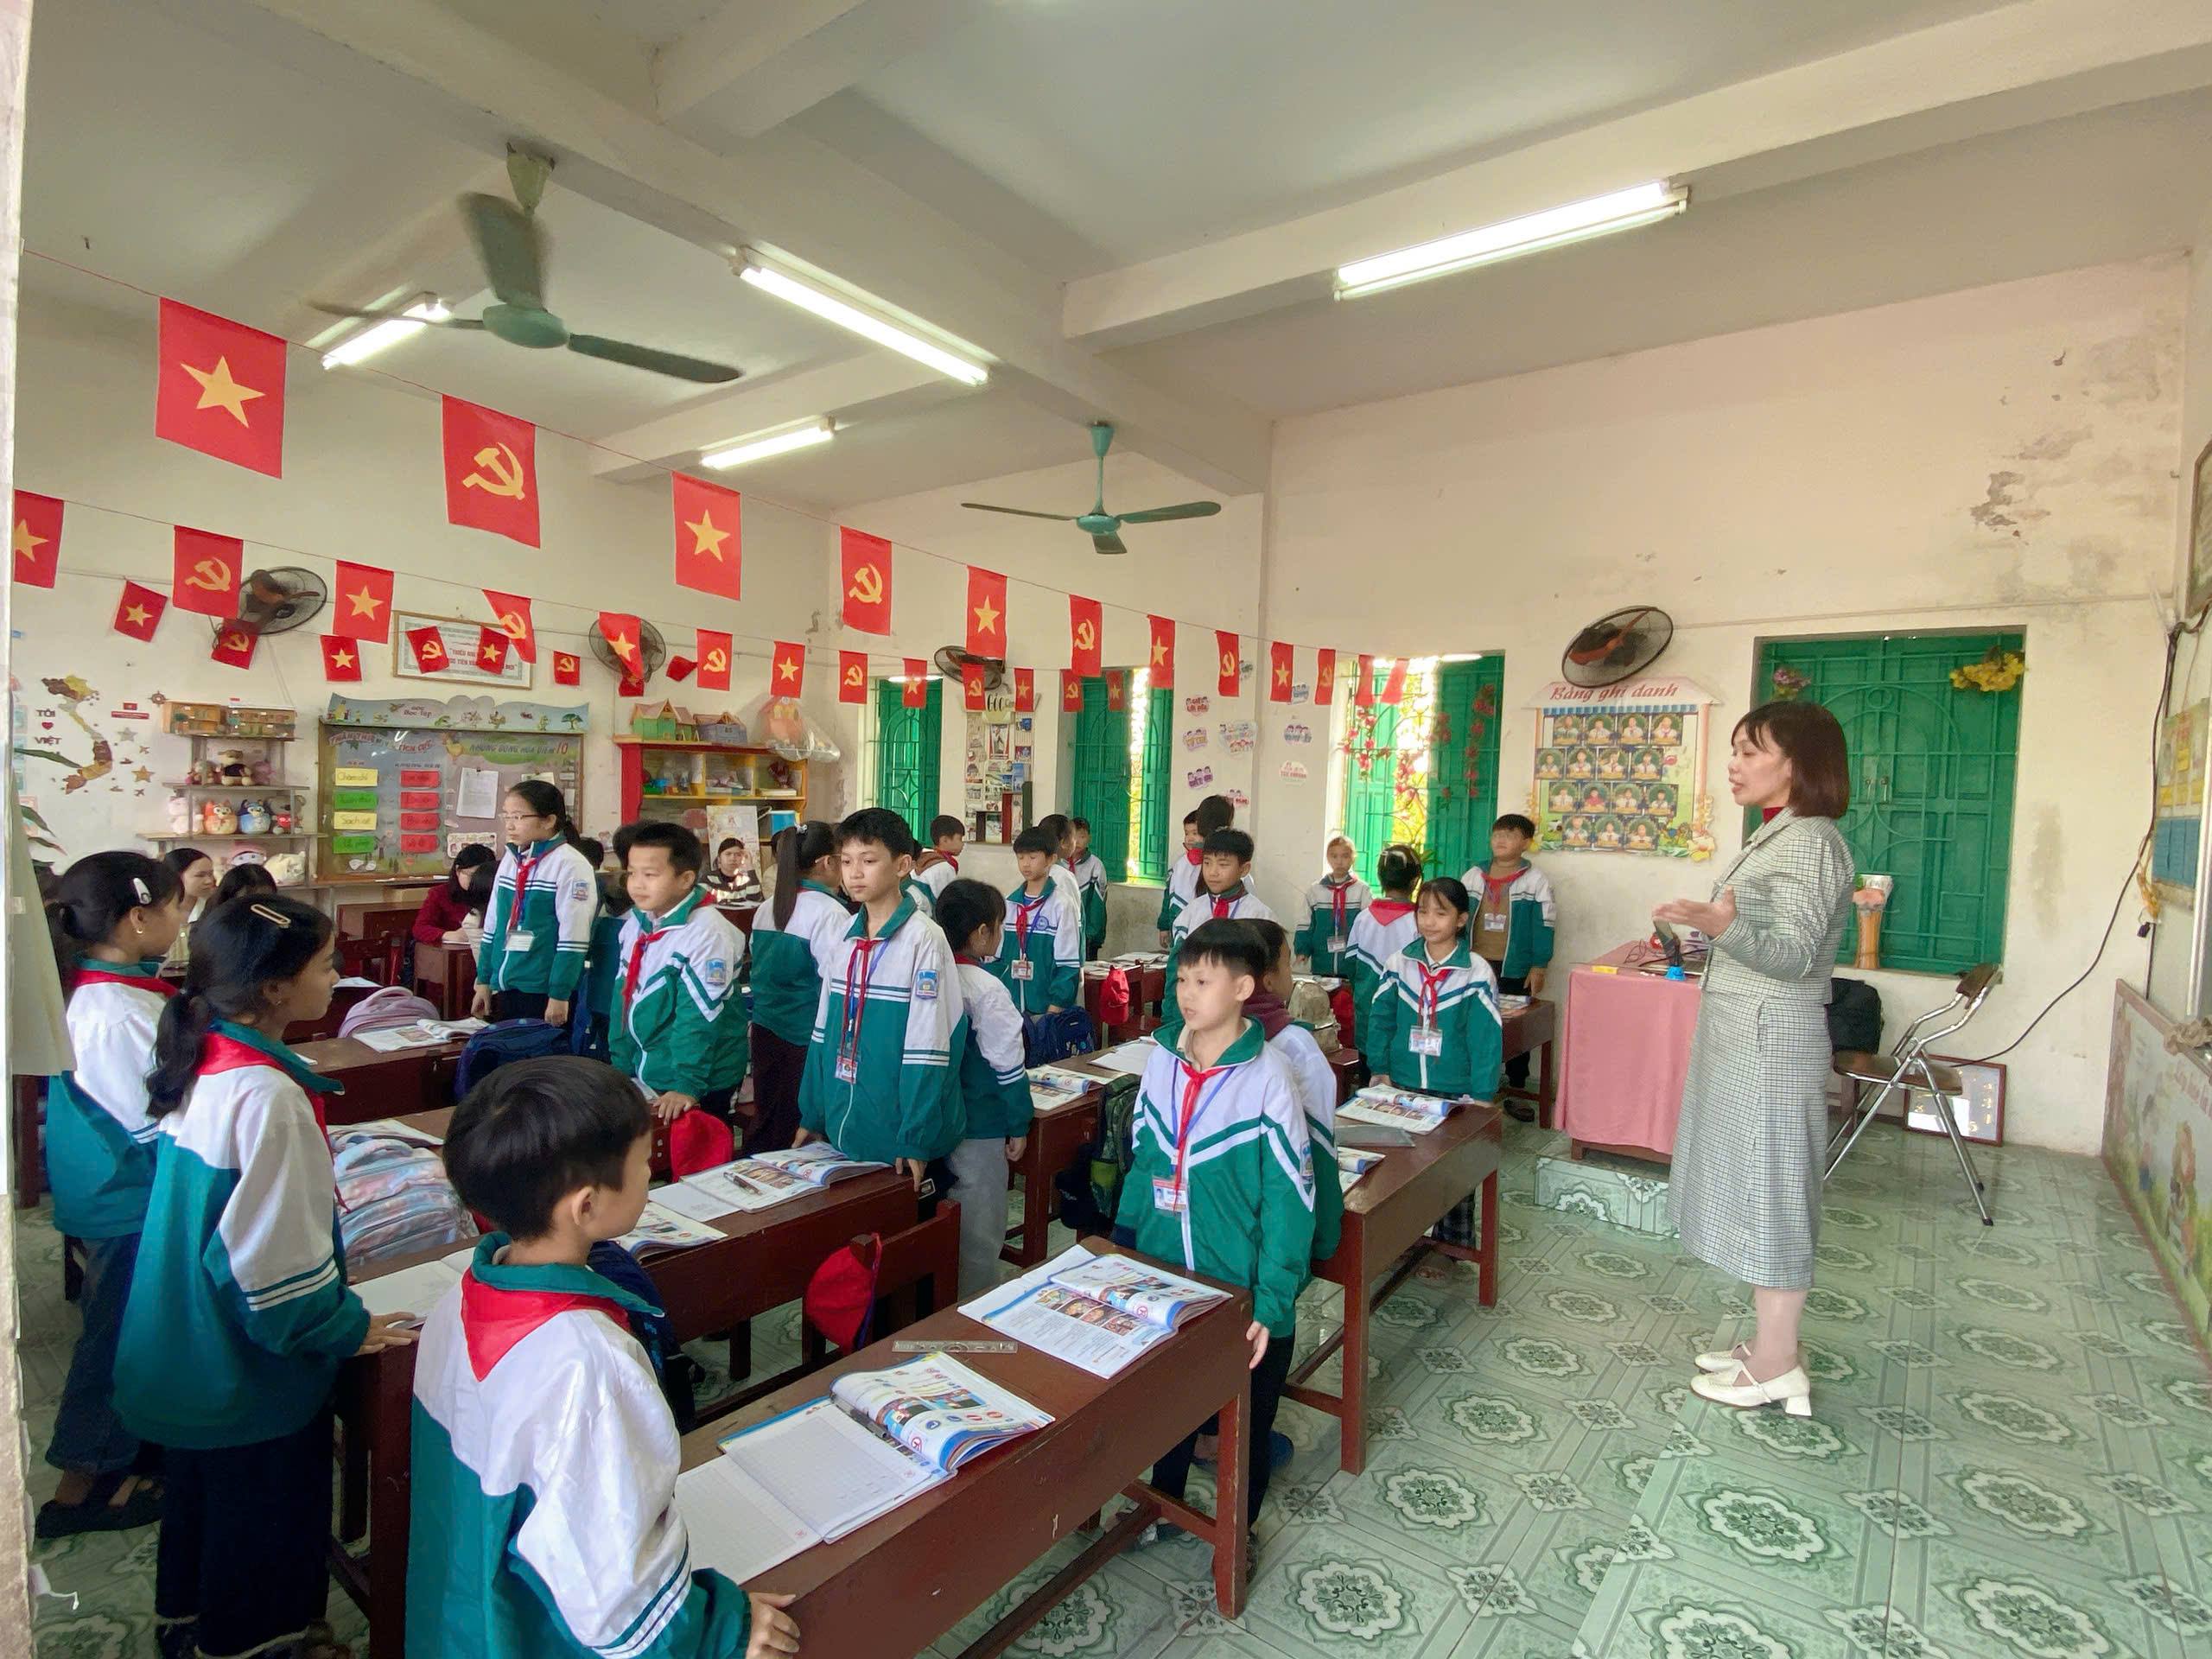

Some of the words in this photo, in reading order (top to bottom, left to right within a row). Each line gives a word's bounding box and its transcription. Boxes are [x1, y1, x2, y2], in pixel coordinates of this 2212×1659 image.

[1599, 683, 1627, 702] ghi
[1630, 683, 1680, 698] danh
[35, 709, 55, 718] TÔI
[34, 735, 62, 747] VIỆT
[557, 742, 569, 754] 10
